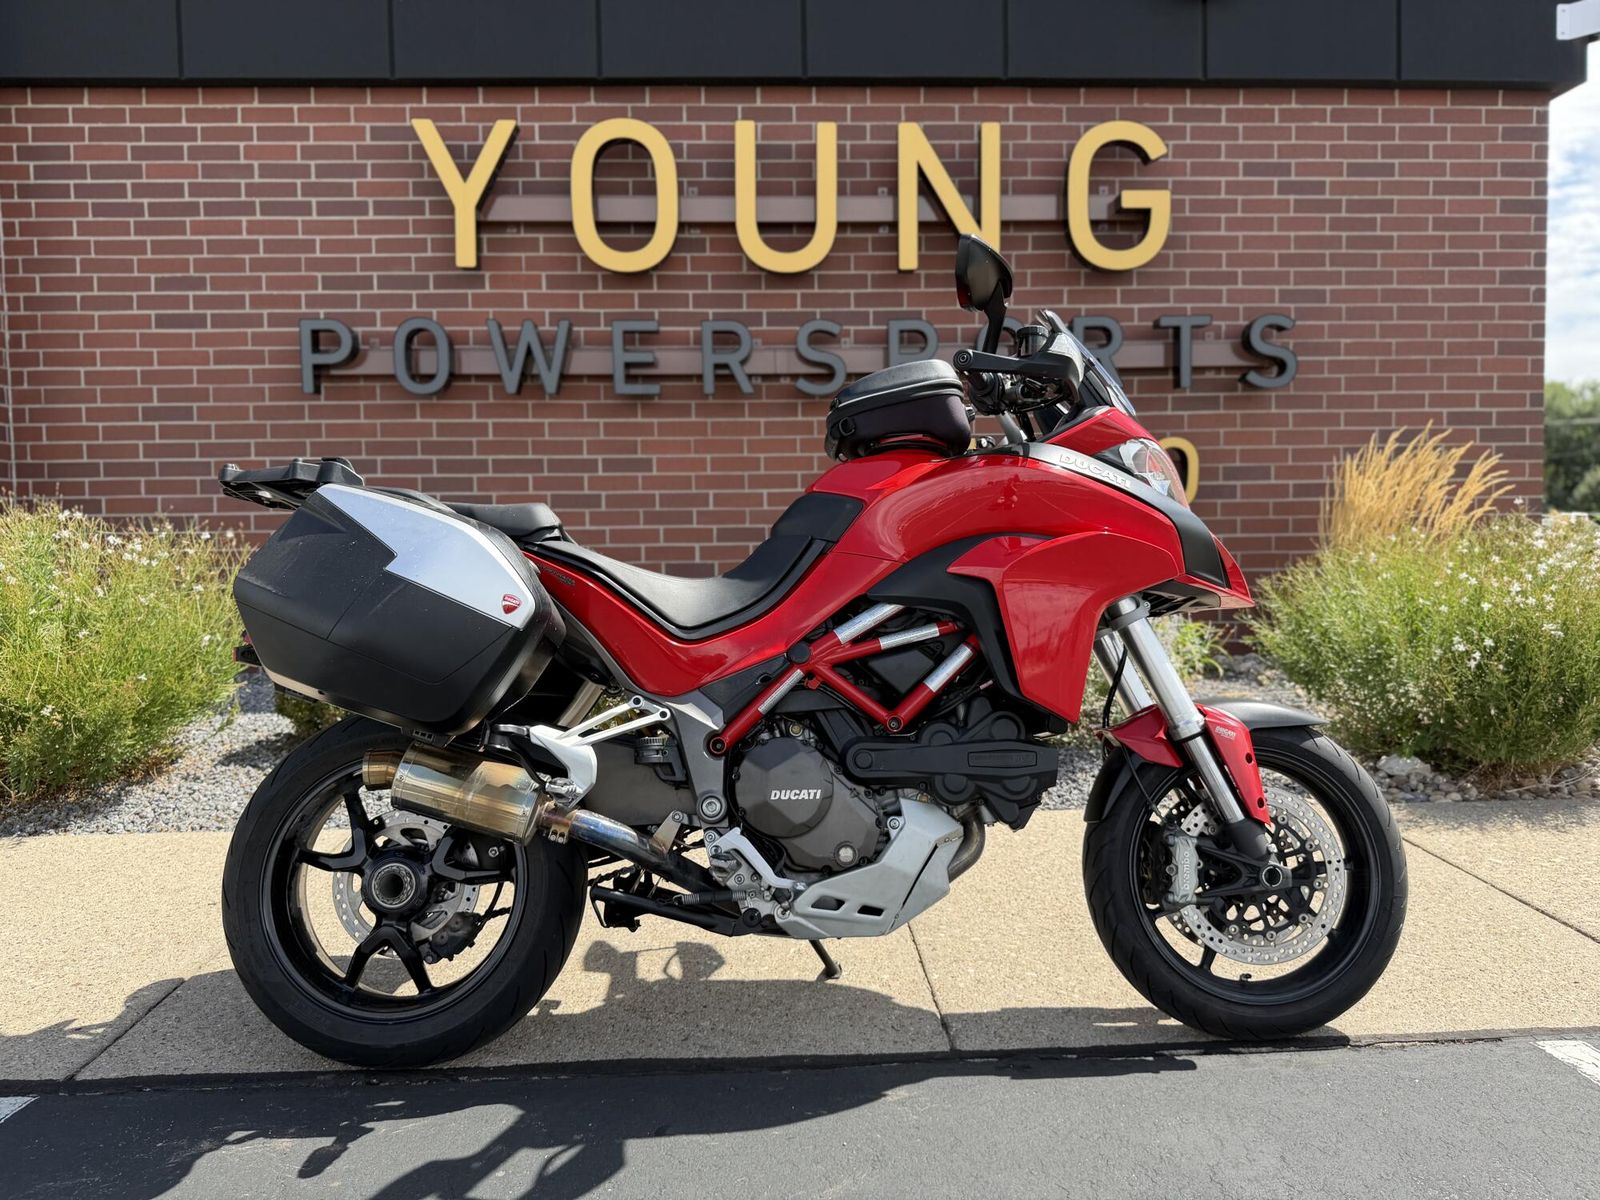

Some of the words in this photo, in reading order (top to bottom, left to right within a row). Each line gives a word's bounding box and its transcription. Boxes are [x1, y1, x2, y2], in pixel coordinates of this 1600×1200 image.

[411, 117, 1172, 273] YOUNG
[1059, 454, 1131, 489] DUCATI
[770, 788, 822, 801] DUCATI
[1181, 850, 1191, 890] brembo
